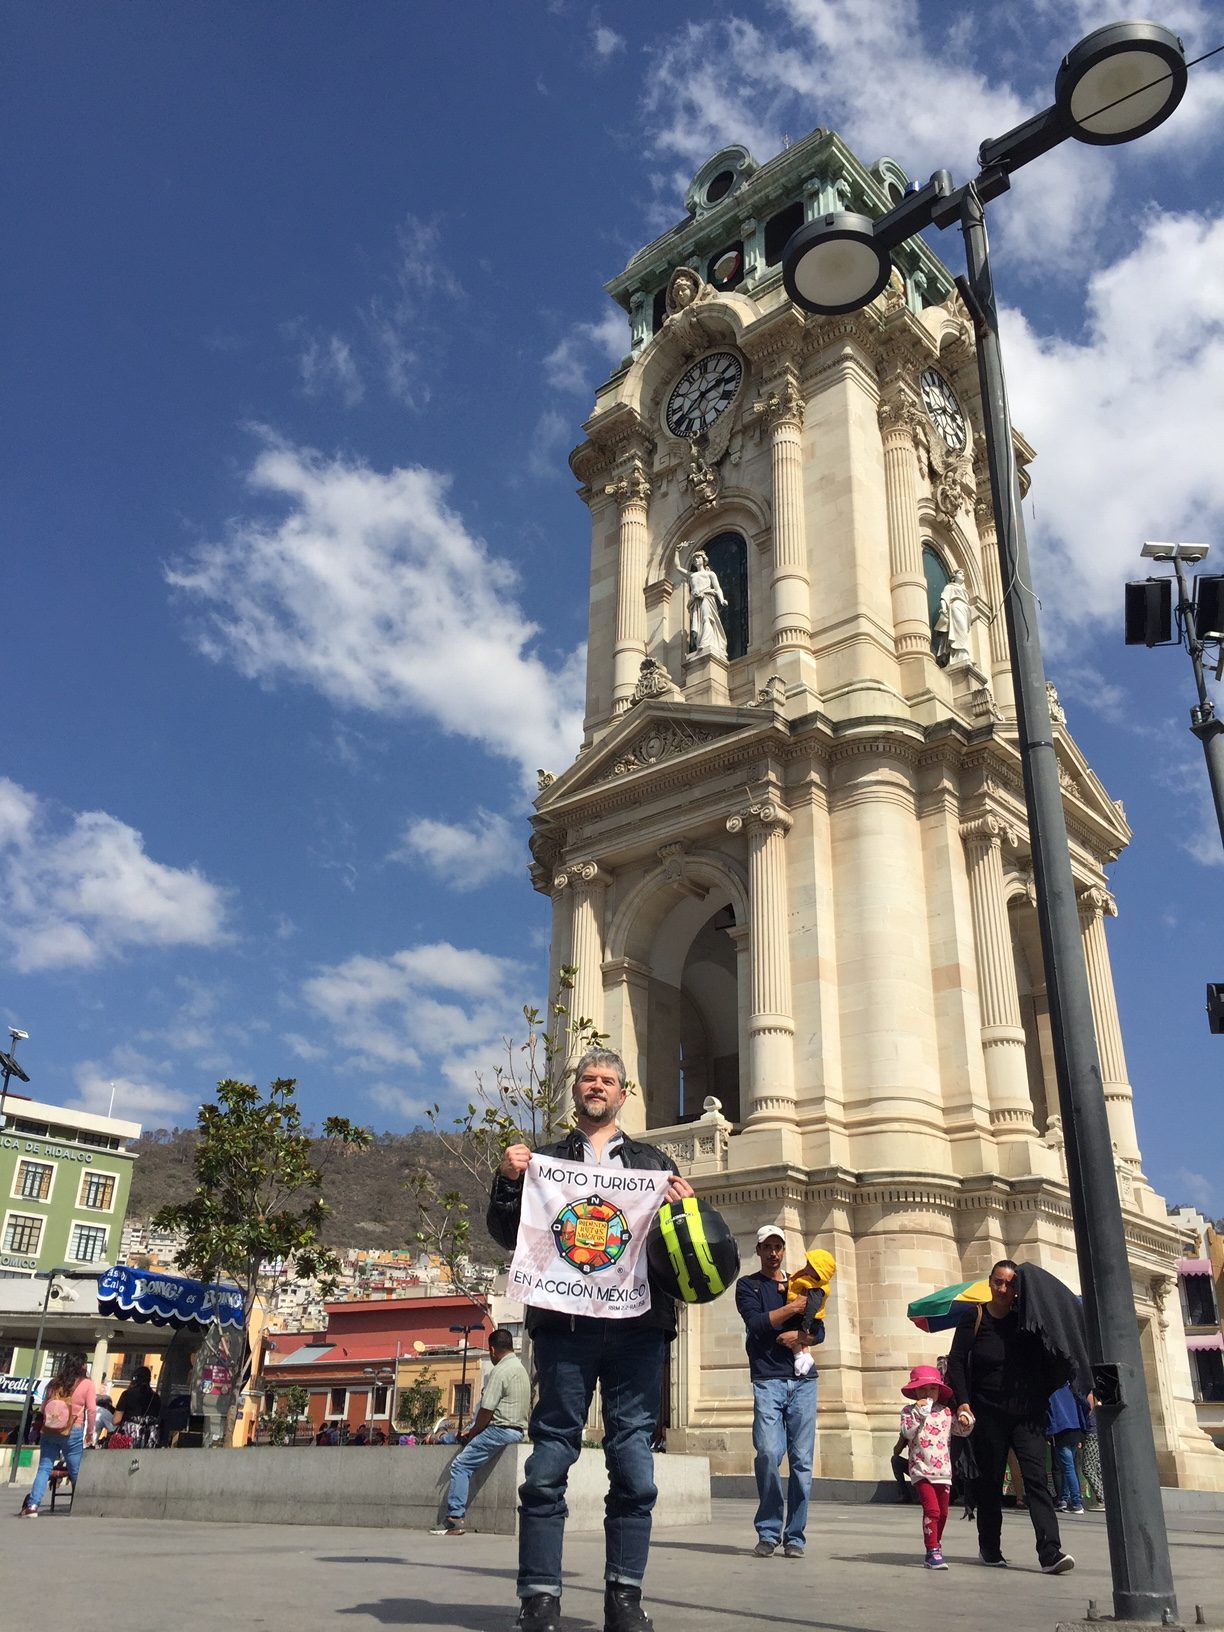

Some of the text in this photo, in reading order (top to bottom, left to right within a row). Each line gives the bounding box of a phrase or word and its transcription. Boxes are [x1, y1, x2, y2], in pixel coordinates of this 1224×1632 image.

[25, 1141, 40, 1152] DE
[44, 1145, 93, 1163] HIDALGO
[538, 1165, 656, 1192] MOTO TURISTA
[131, 1278, 184, 1300] BOING!
[514, 1270, 646, 1302] EN ACCIÓN MÉXICO
